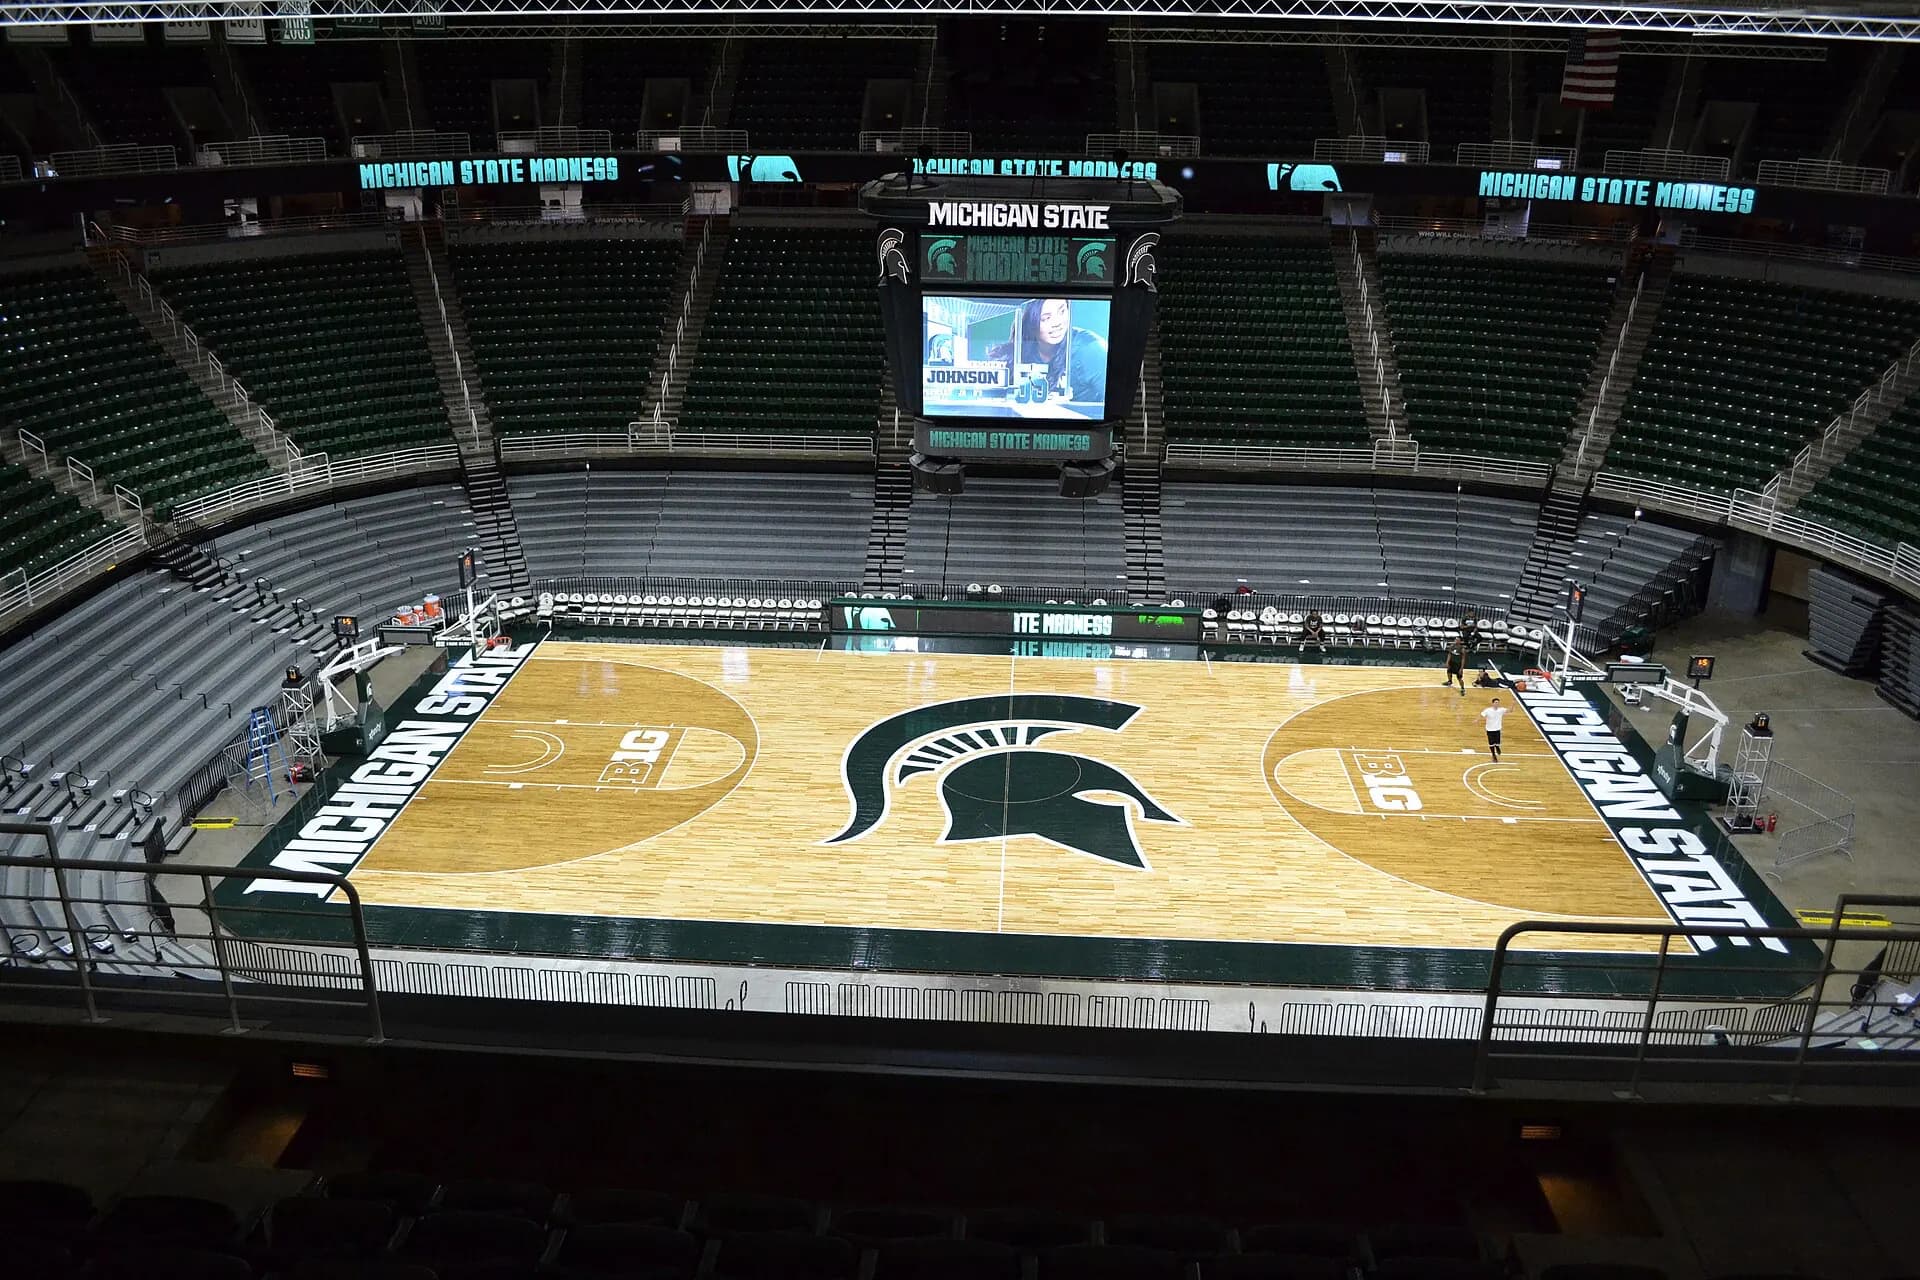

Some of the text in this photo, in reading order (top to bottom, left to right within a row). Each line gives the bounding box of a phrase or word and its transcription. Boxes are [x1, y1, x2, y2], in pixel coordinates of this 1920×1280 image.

[359, 157, 619, 189] MICHIGAN STATE MADNESS
[1478, 171, 1756, 214] MICHIGAN STATE MADNESS
[927, 202, 1111, 230] MICHIGAN STATE
[967, 235, 1069, 254] MICHIGAN STATE
[967, 252, 1068, 283] MADNESS
[926, 370, 999, 385] JOHNSON
[929, 430, 1090, 451] MICHIGAN STATE MADNESS
[1042, 613, 1112, 635] MADNESS
[242, 720, 470, 899] MICHIGAN
[1616, 827, 1790, 954] STATE
